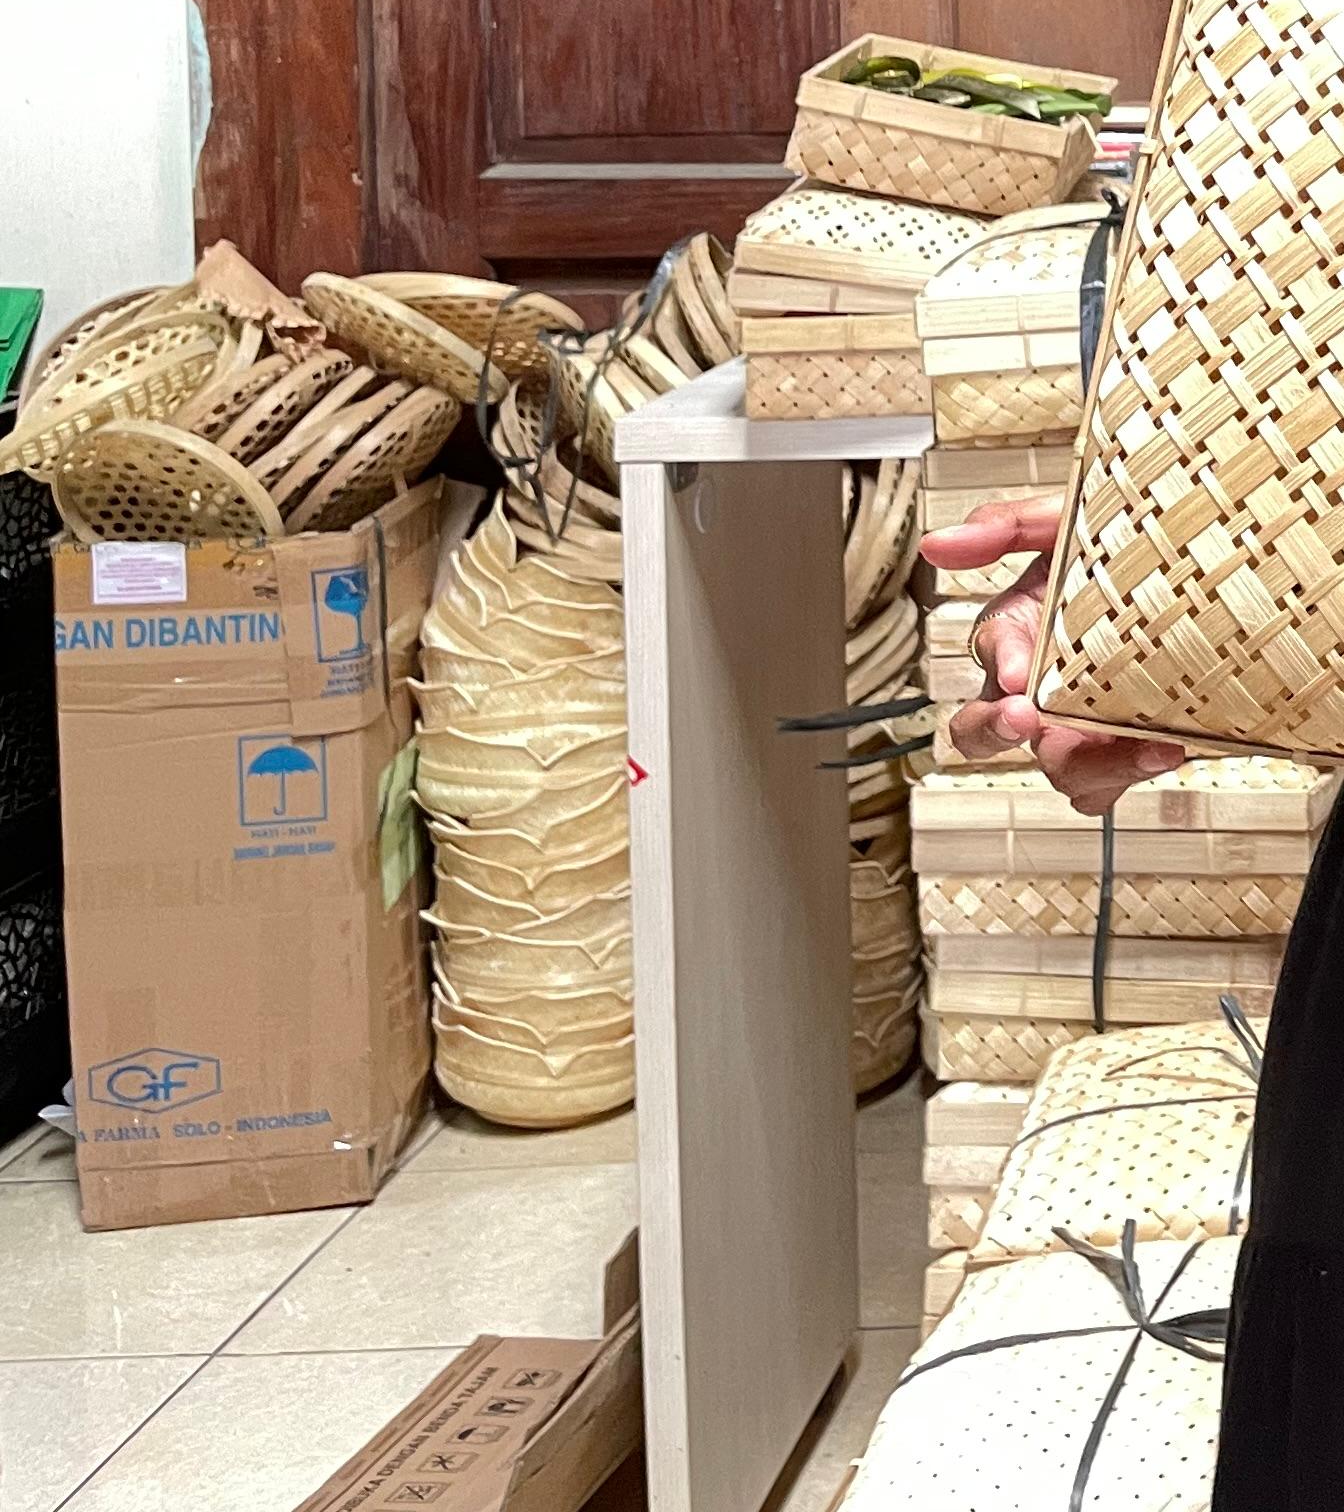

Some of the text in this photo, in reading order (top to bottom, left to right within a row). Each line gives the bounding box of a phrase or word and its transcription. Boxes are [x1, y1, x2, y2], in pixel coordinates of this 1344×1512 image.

[95, 1127, 160, 1143] FARMA
[173, 1121, 221, 1138] SOLO
[236, 1109, 333, 1133] INDONESIA
[457, 1367, 500, 1399] TAJAM
